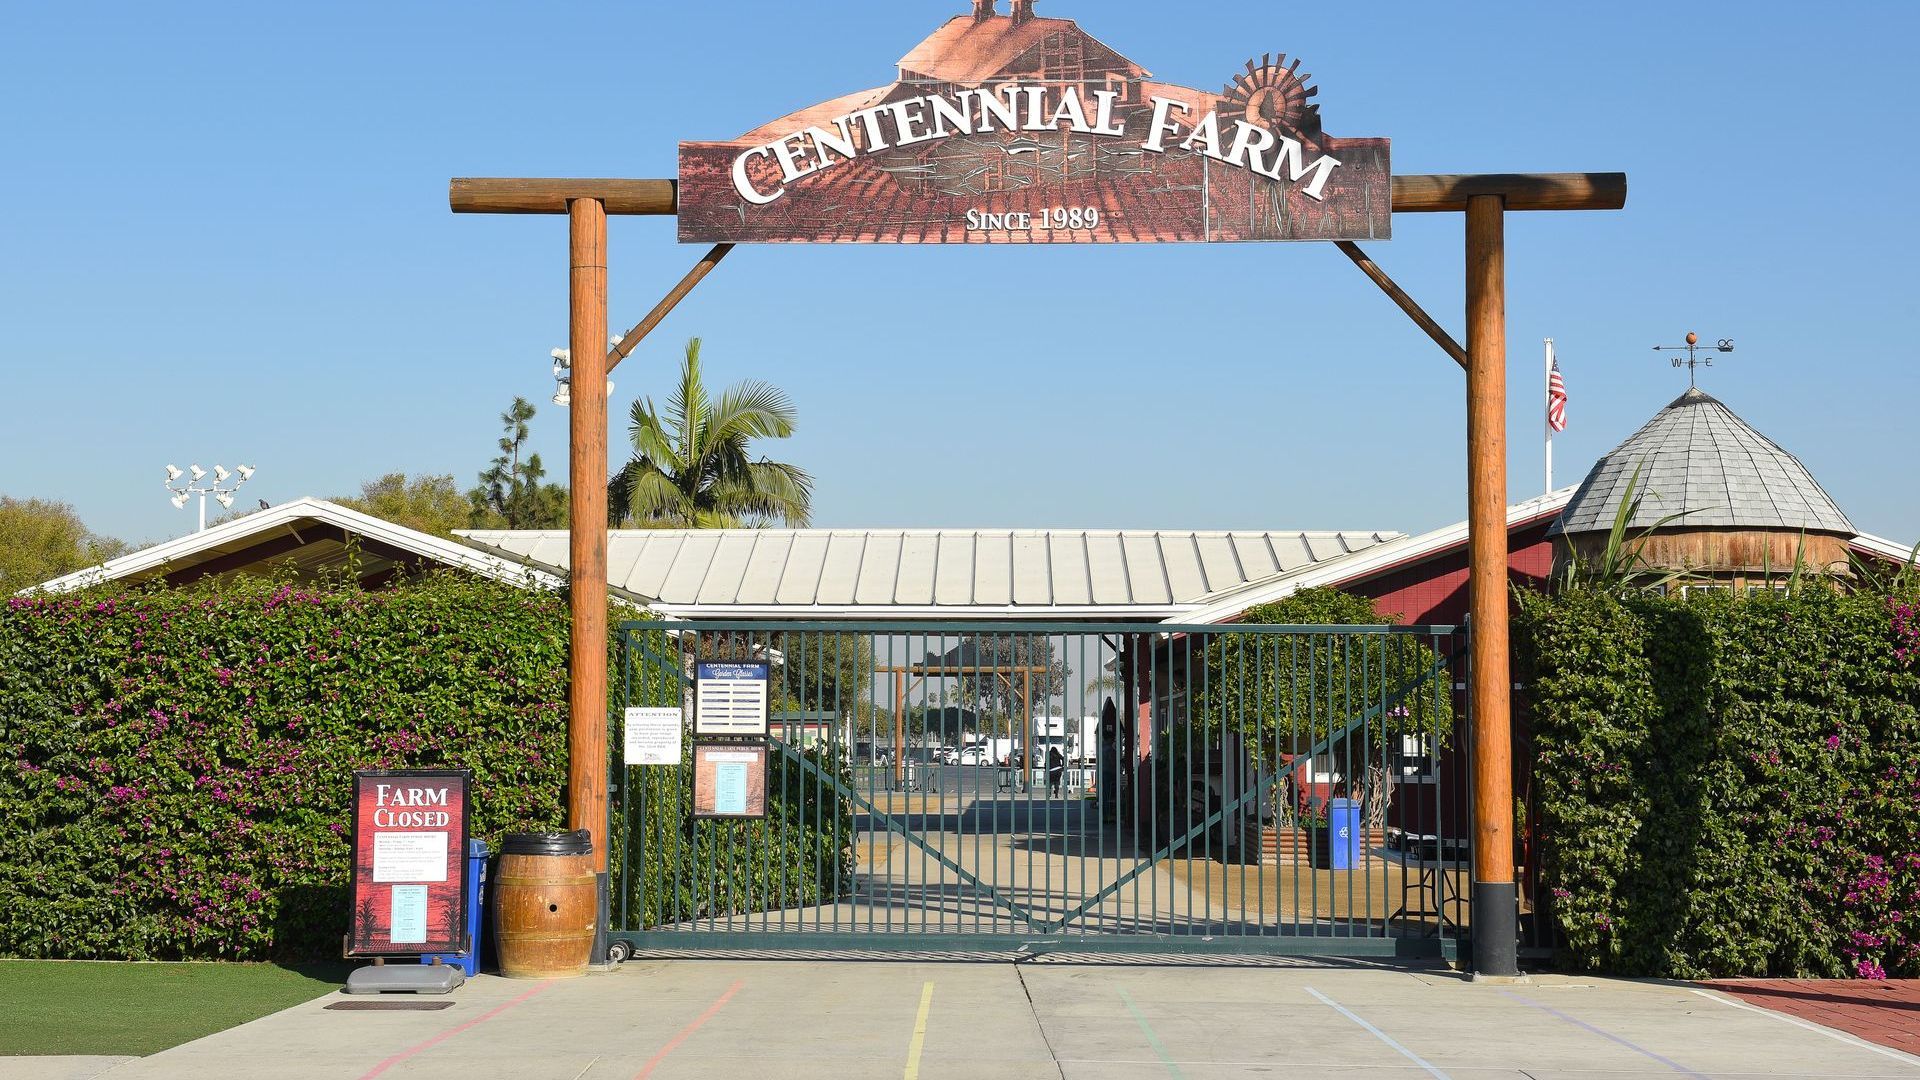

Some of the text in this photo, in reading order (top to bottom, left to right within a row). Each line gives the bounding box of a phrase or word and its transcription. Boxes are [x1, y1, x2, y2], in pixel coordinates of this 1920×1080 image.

[732, 86, 1342, 205] CENTENNIAL FARM
[966, 207, 1099, 230] SINCE 1989
[376, 784, 449, 807] FARM
[373, 808, 450, 828] CLOSED
